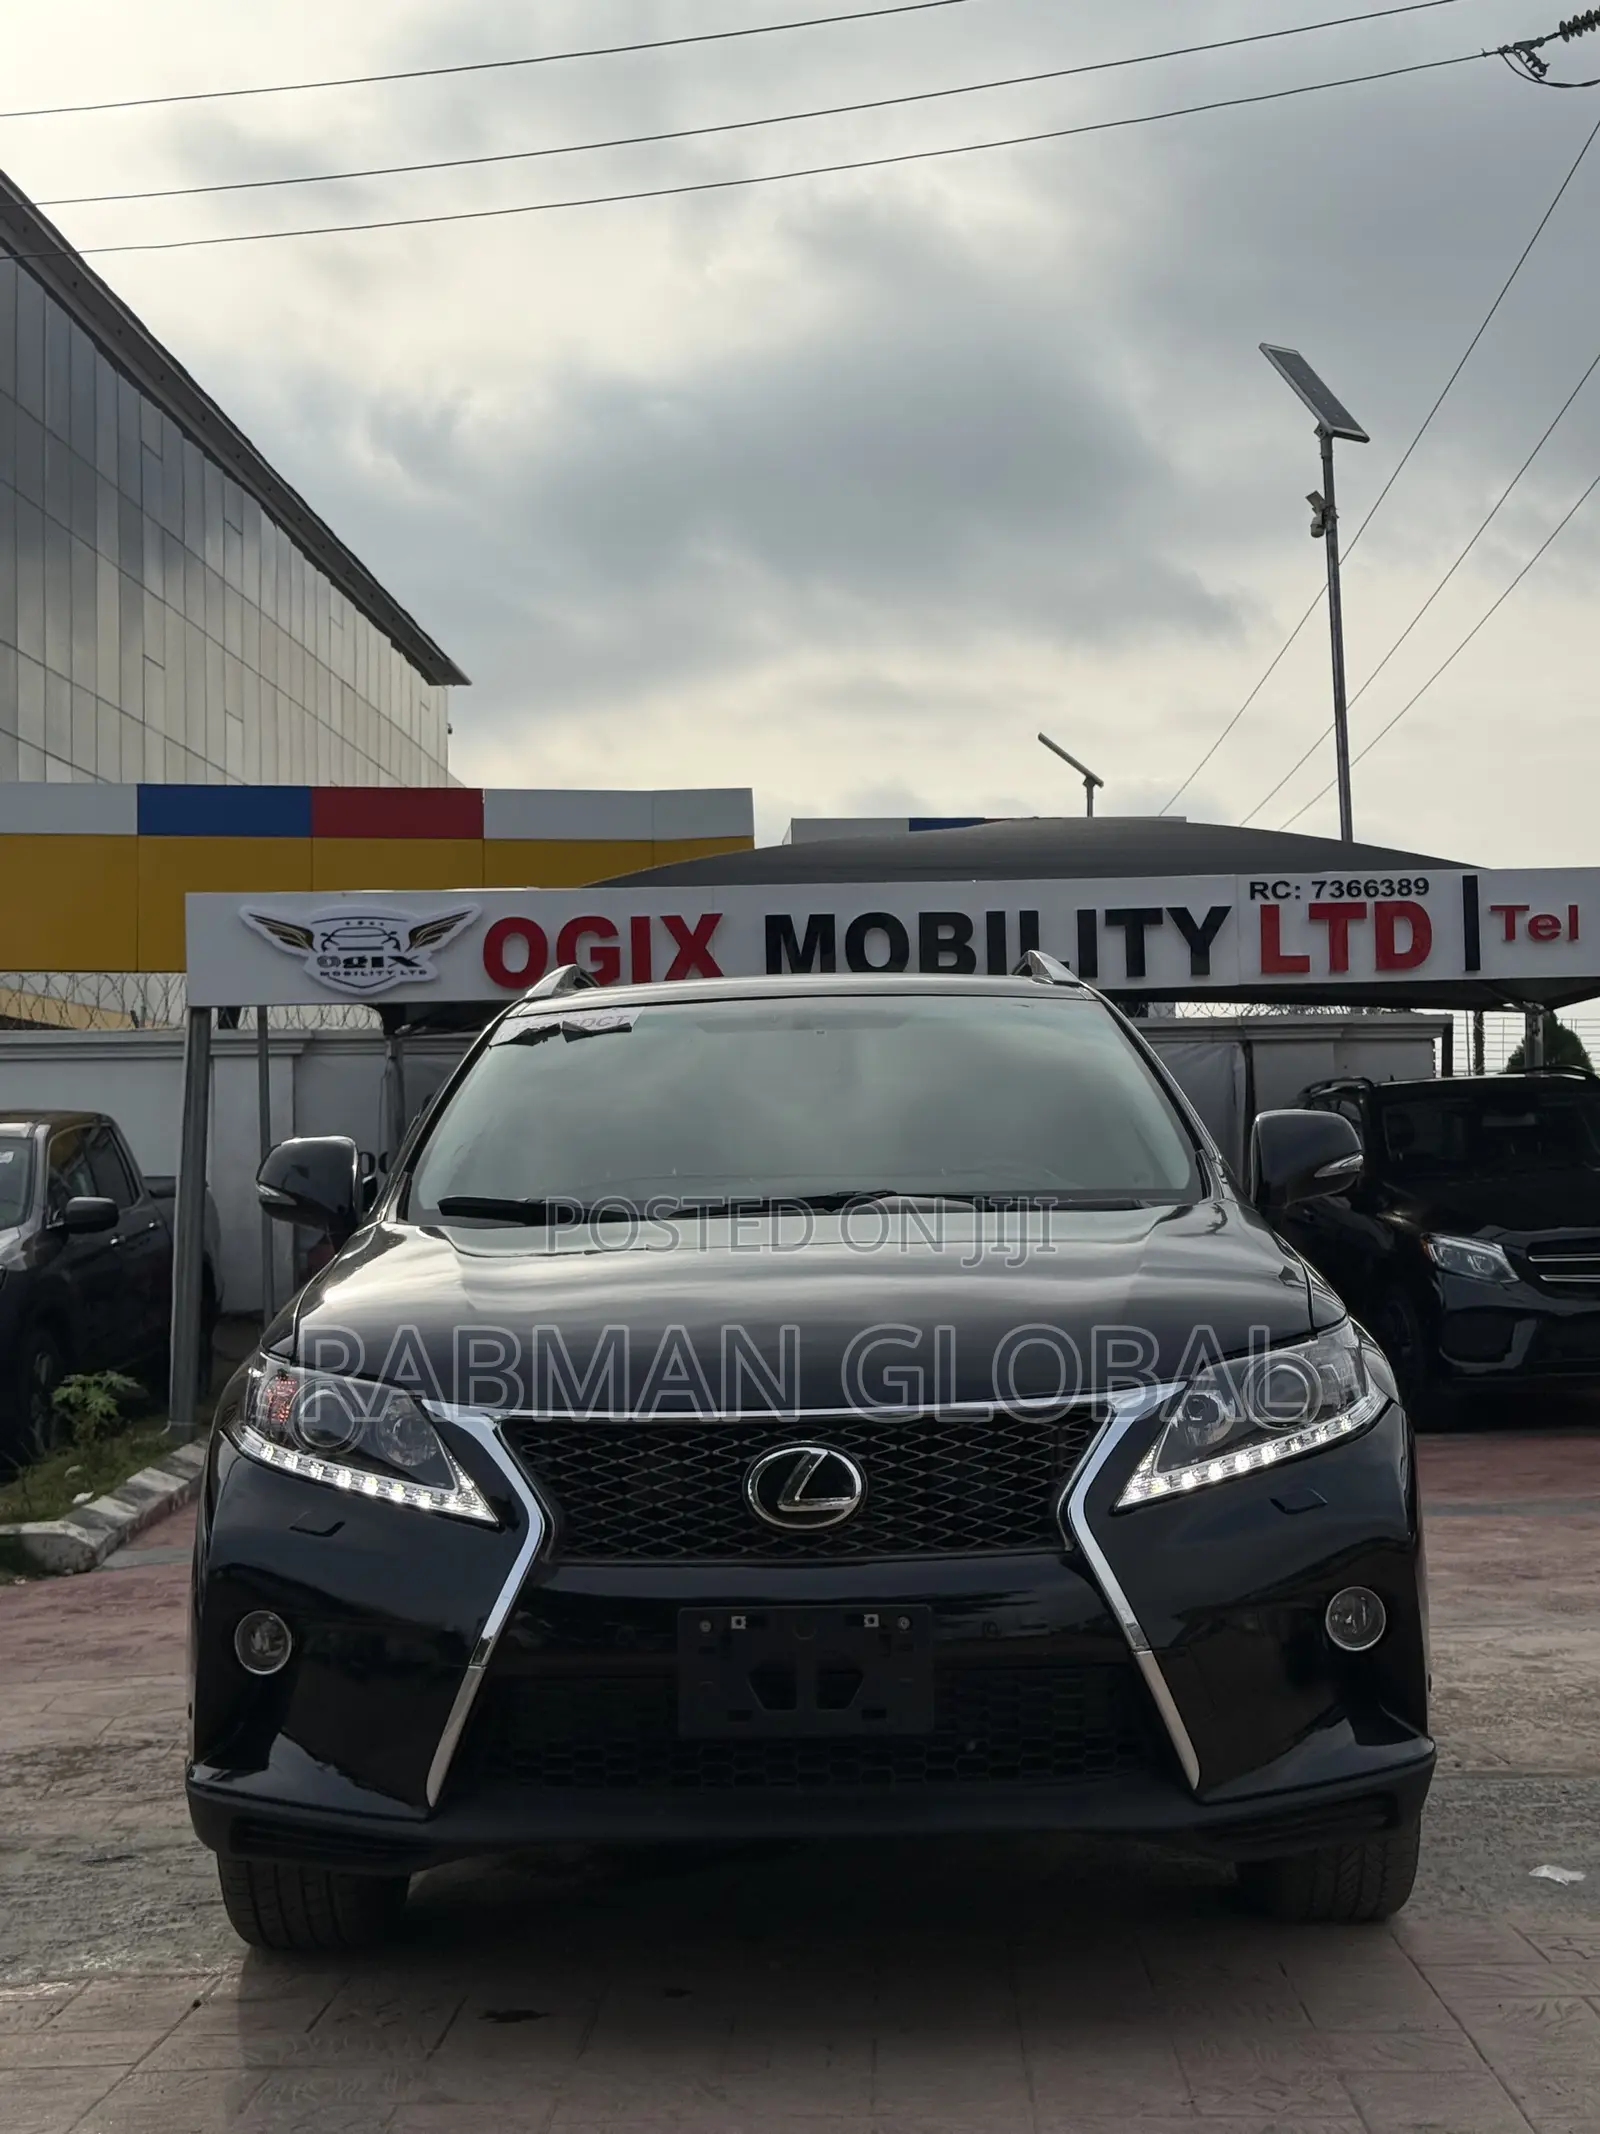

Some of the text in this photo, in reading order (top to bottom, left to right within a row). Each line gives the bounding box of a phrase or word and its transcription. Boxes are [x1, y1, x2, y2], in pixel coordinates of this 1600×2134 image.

[1249, 877, 1430, 900] RC: 7366389
[1489, 904, 1580, 941] Tel
[483, 900, 1433, 990] OGIX MOBILITY LTD
